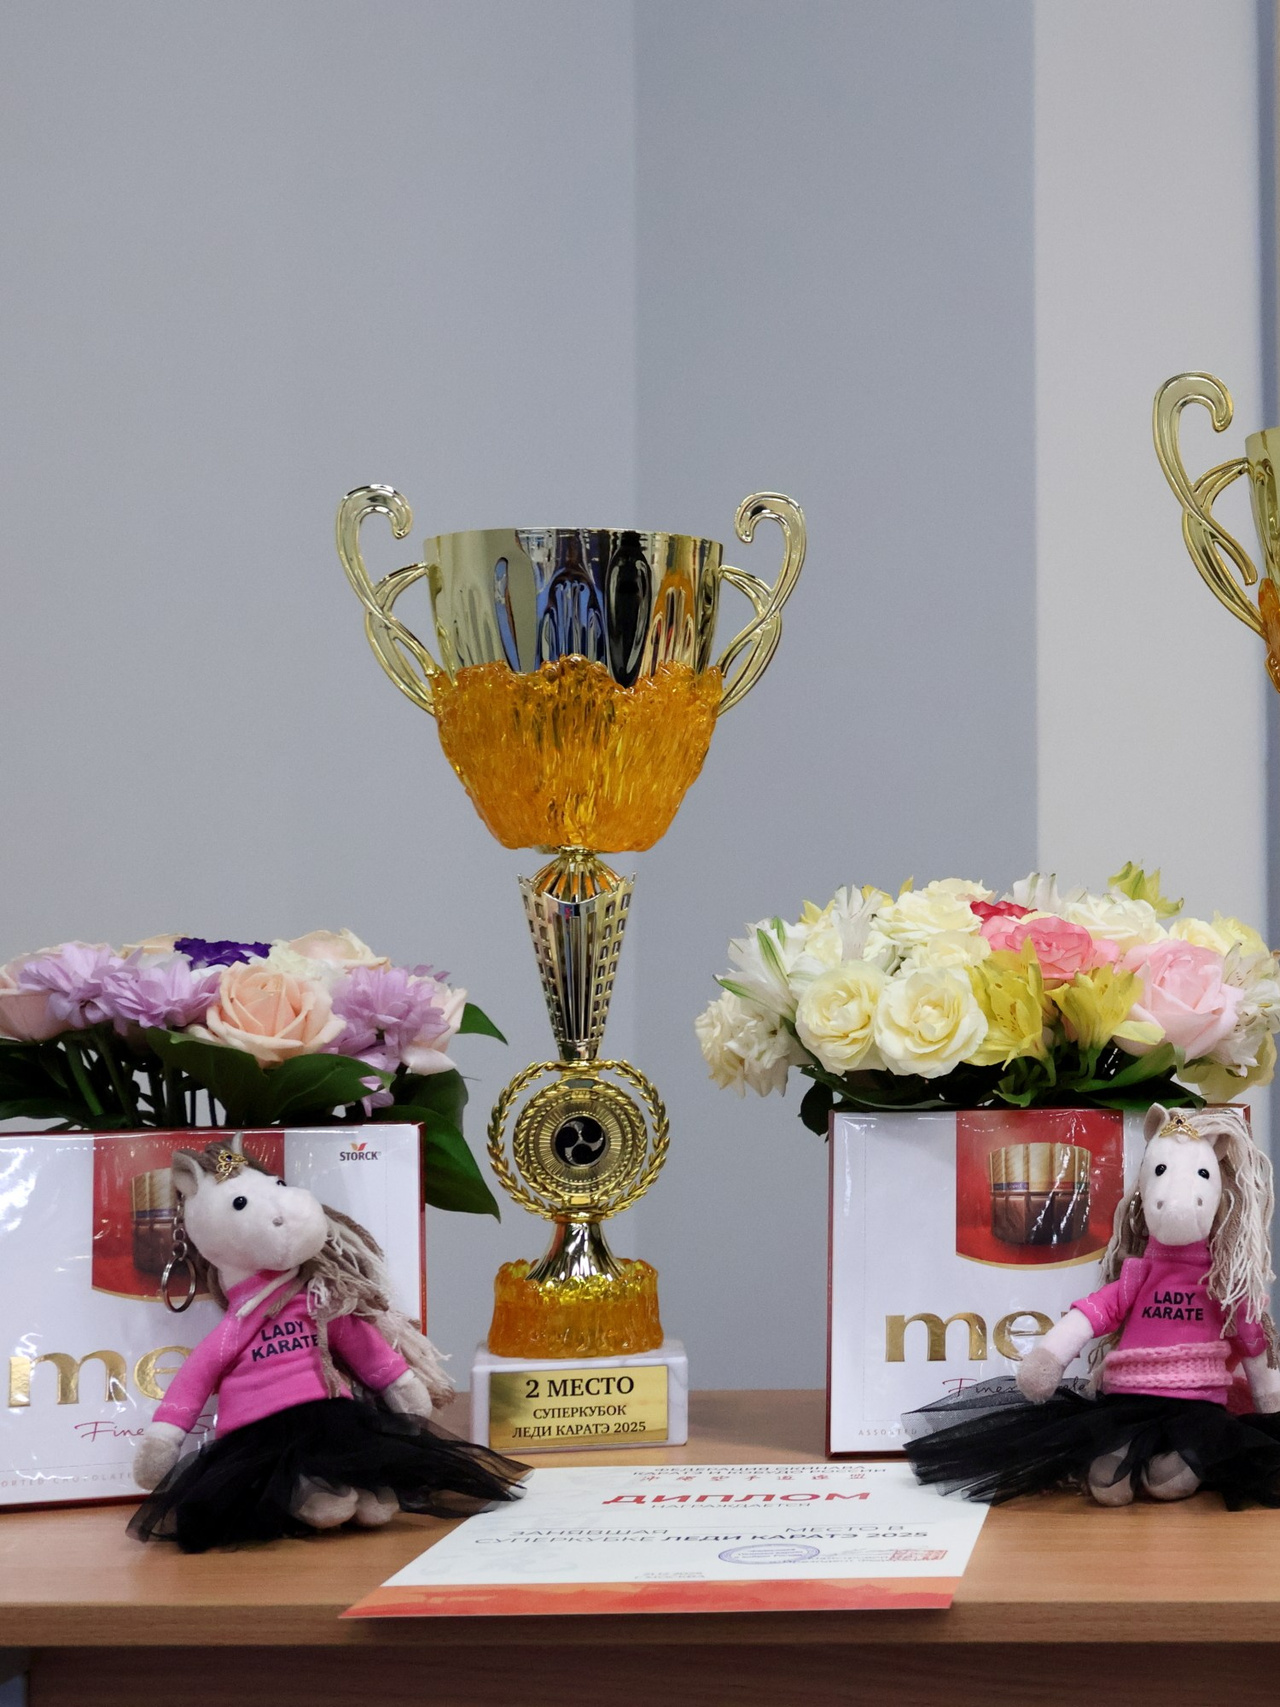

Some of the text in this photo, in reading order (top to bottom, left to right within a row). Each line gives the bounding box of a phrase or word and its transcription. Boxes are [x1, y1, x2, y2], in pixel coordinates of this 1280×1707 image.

[339, 1151, 378, 1161] STORCK
[1154, 1291, 1196, 1305] LADY
[1141, 1306, 1204, 1321] KARATE
[261, 1320, 304, 1342] LADY
[885, 1311, 1055, 1362] me
[525, 1376, 635, 1398] 2 МЕСТО
[533, 1404, 627, 1420] СУПЕРКУБОК
[74, 1421, 145, 1442] Fine
[512, 1421, 646, 1440] ЛЕДИ КАРАТЭ 2025
[602, 1492, 870, 1505] ДИПЛОМ
[475, 1536, 655, 1544] СУПЕРКУБКЕ
[661, 1534, 742, 1542] ЛЕДИ
[751, 1533, 858, 1541] КАРАТЭ
[509, 1529, 669, 1537] ЗАНЯВШАЯ
